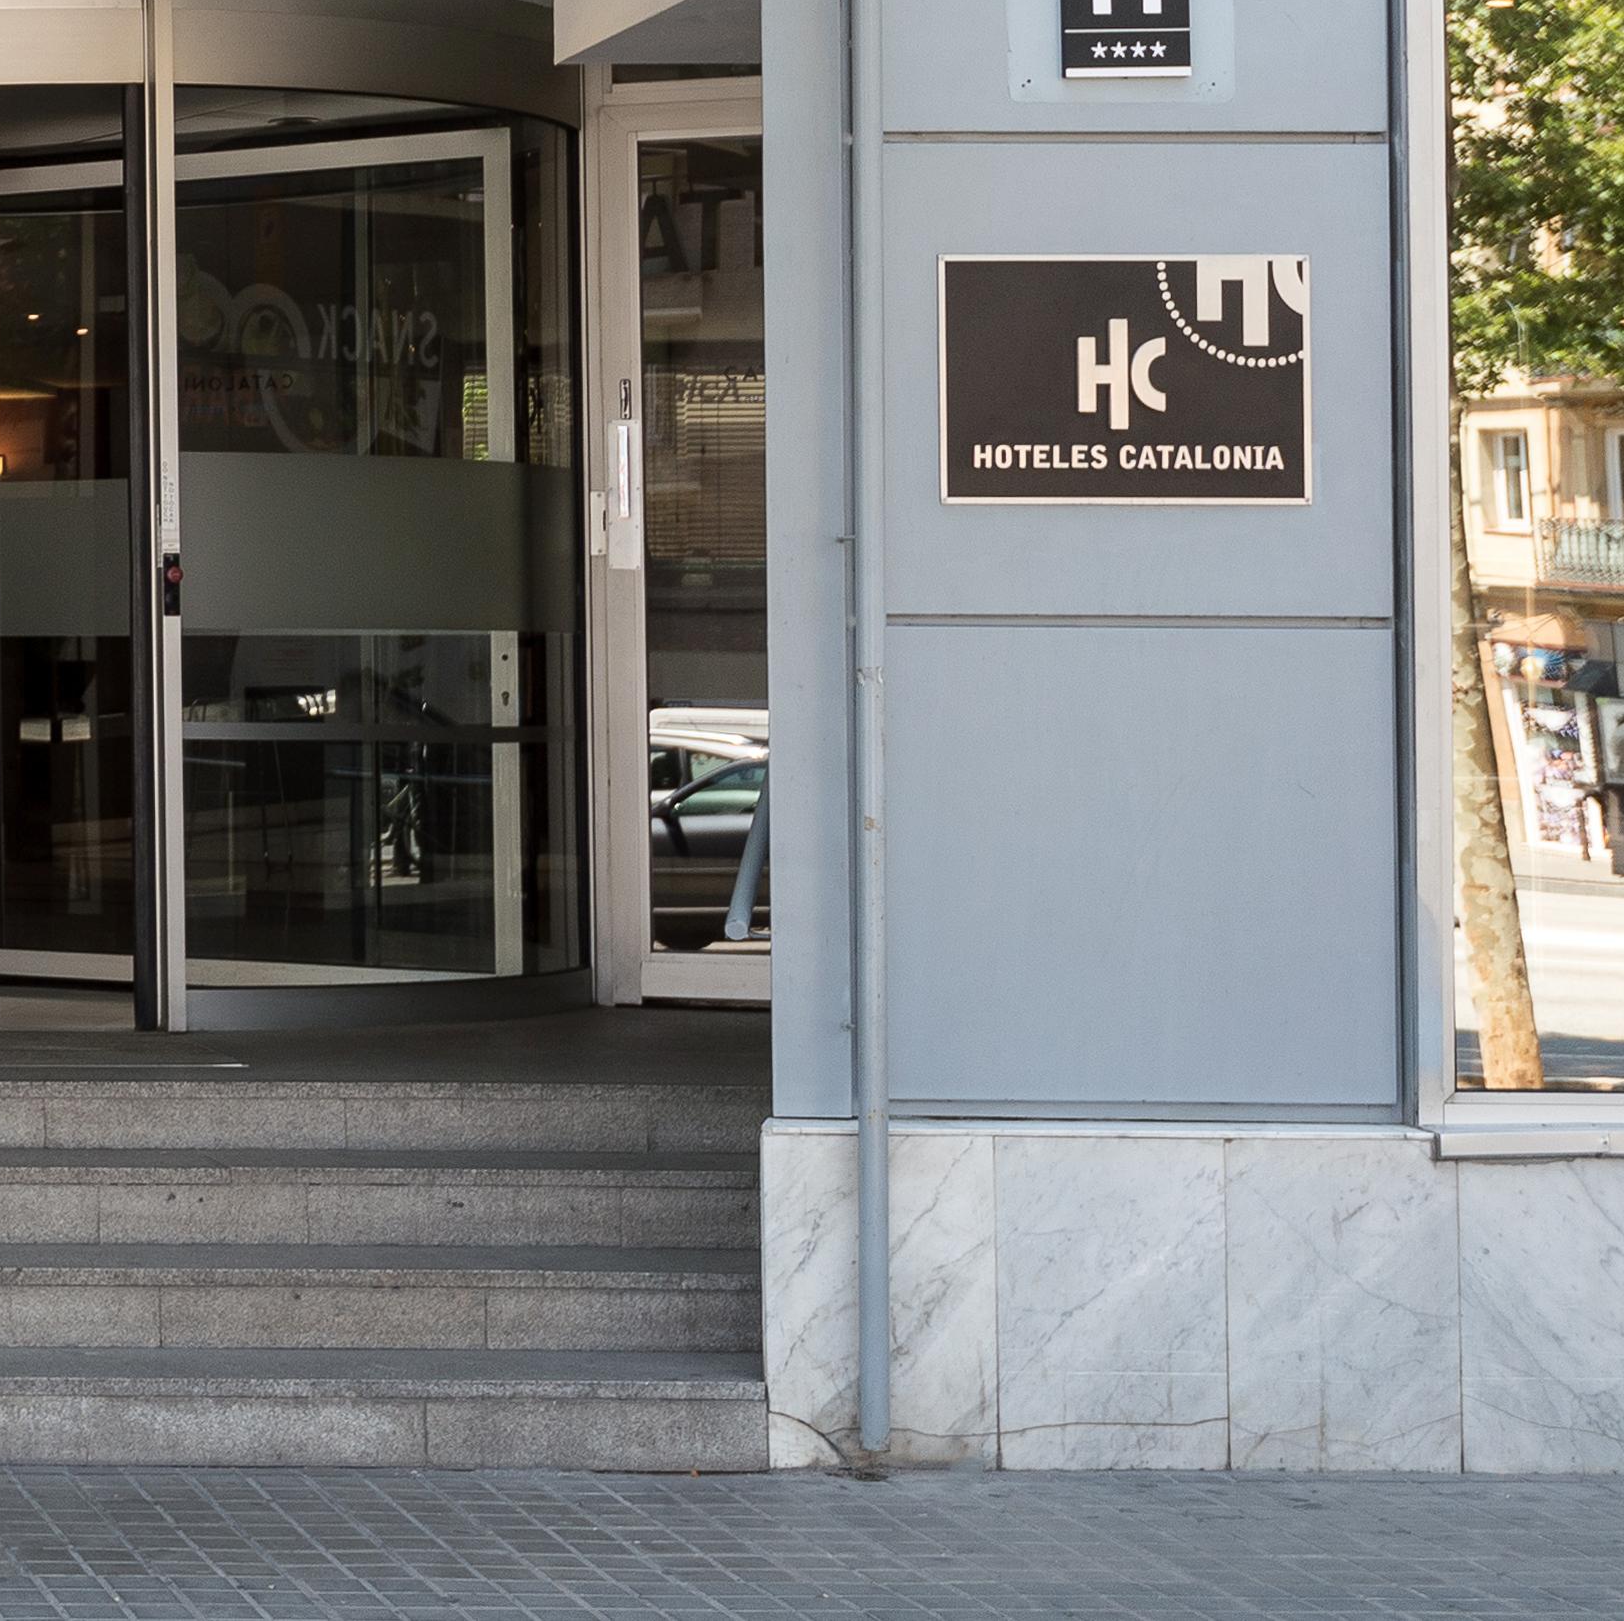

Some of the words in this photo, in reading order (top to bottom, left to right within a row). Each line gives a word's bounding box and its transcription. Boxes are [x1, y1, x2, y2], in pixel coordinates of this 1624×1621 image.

[1077, 318, 1166, 430] HC
[973, 444, 1108, 470] HOTELES
[1119, 445, 1285, 471] CATALONIA
